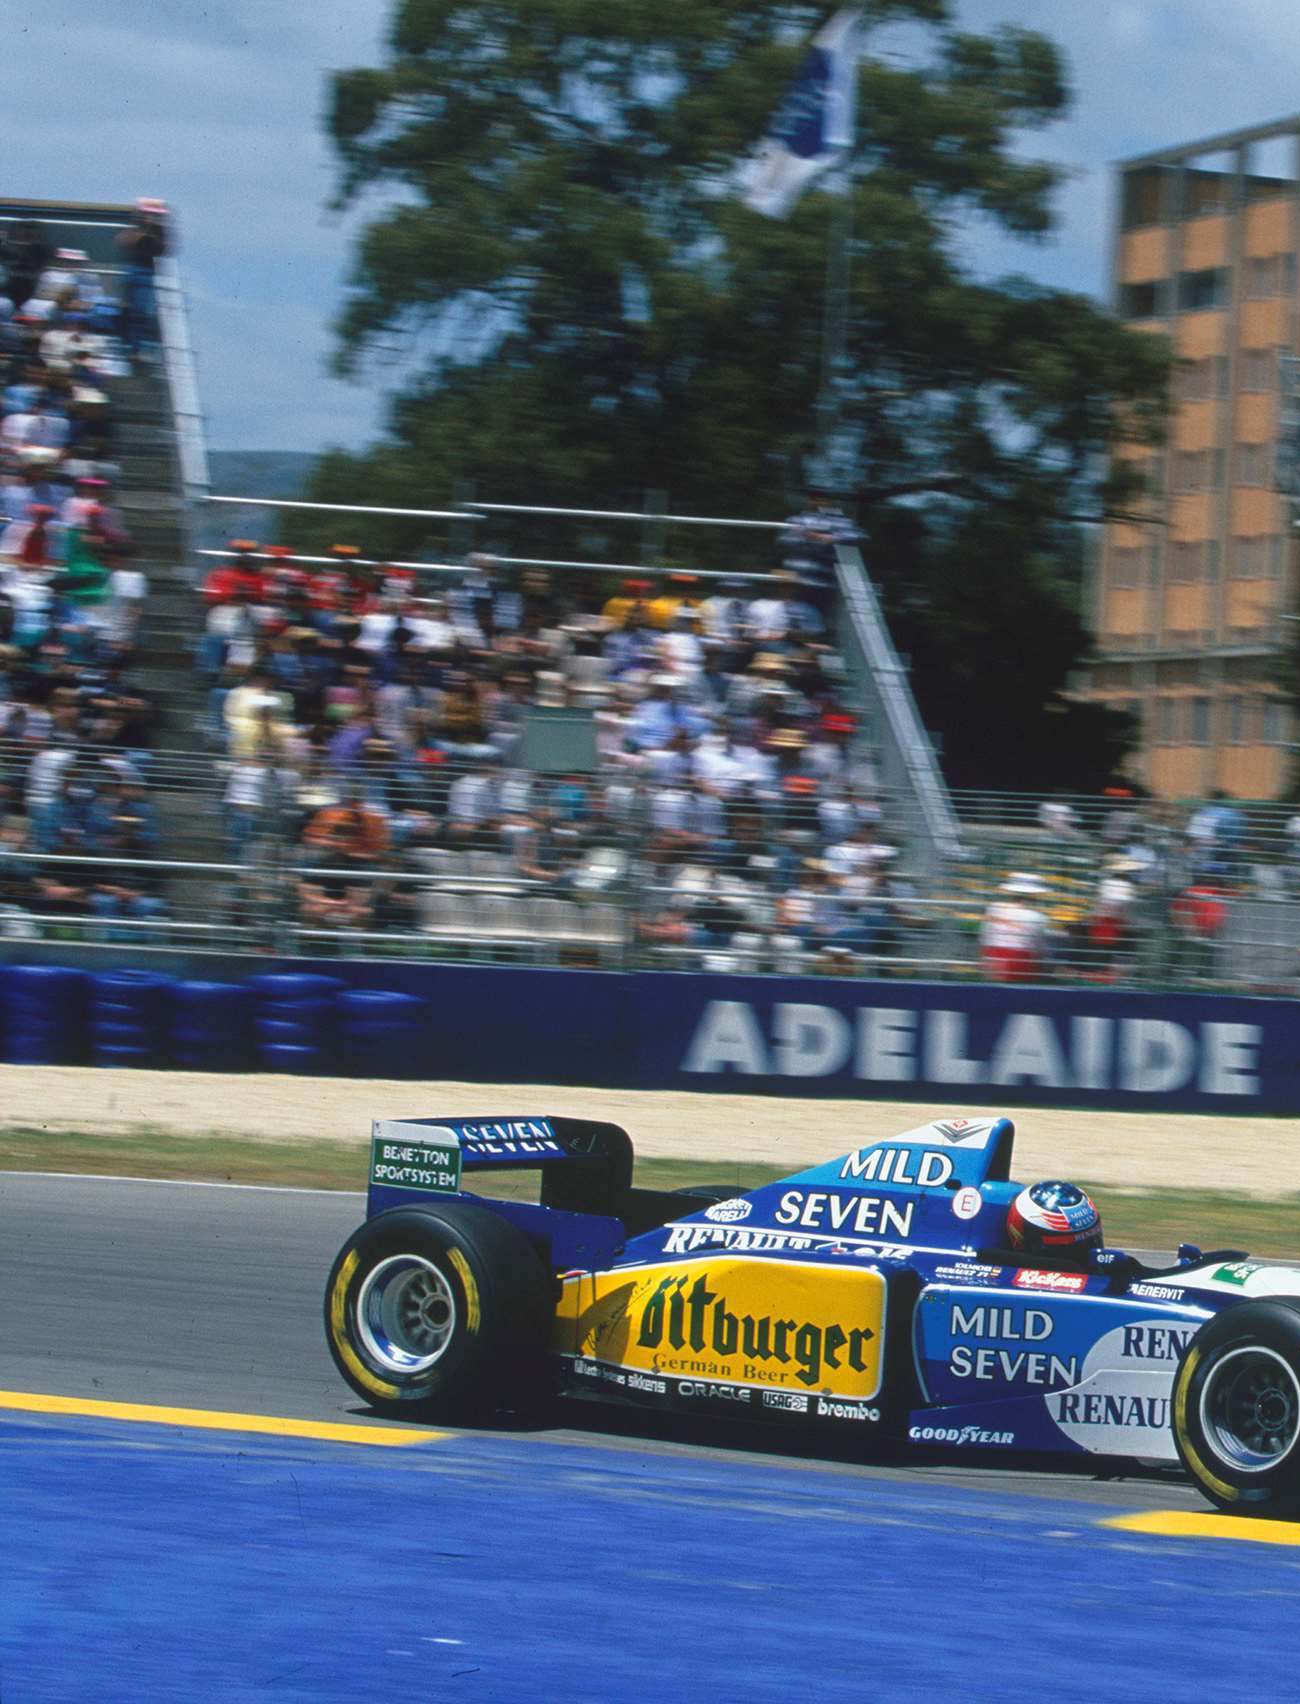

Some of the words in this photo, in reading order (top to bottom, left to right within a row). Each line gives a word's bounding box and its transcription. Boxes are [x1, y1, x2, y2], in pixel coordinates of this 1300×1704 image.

[680, 999, 1263, 1097] ADELAIDE
[383, 1145, 449, 1166] BENETTON
[839, 1149, 954, 1188] MILD
[374, 1164, 456, 1187] SPORTSYSTEM
[775, 1190, 914, 1238] SEVEN
[1096, 1254, 1115, 1265] elf
[951, 1305, 1053, 1341] MILD
[1122, 1326, 1199, 1360] REN
[652, 1352, 732, 1377] German
[743, 1364, 789, 1384] Beer
[950, 1346, 1077, 1387] SEVEN
[678, 1380, 751, 1404] ORACLE
[817, 1397, 880, 1421] brembo
[1057, 1393, 1173, 1428] RENAU
[908, 1426, 1014, 1444] GOODYEAR
